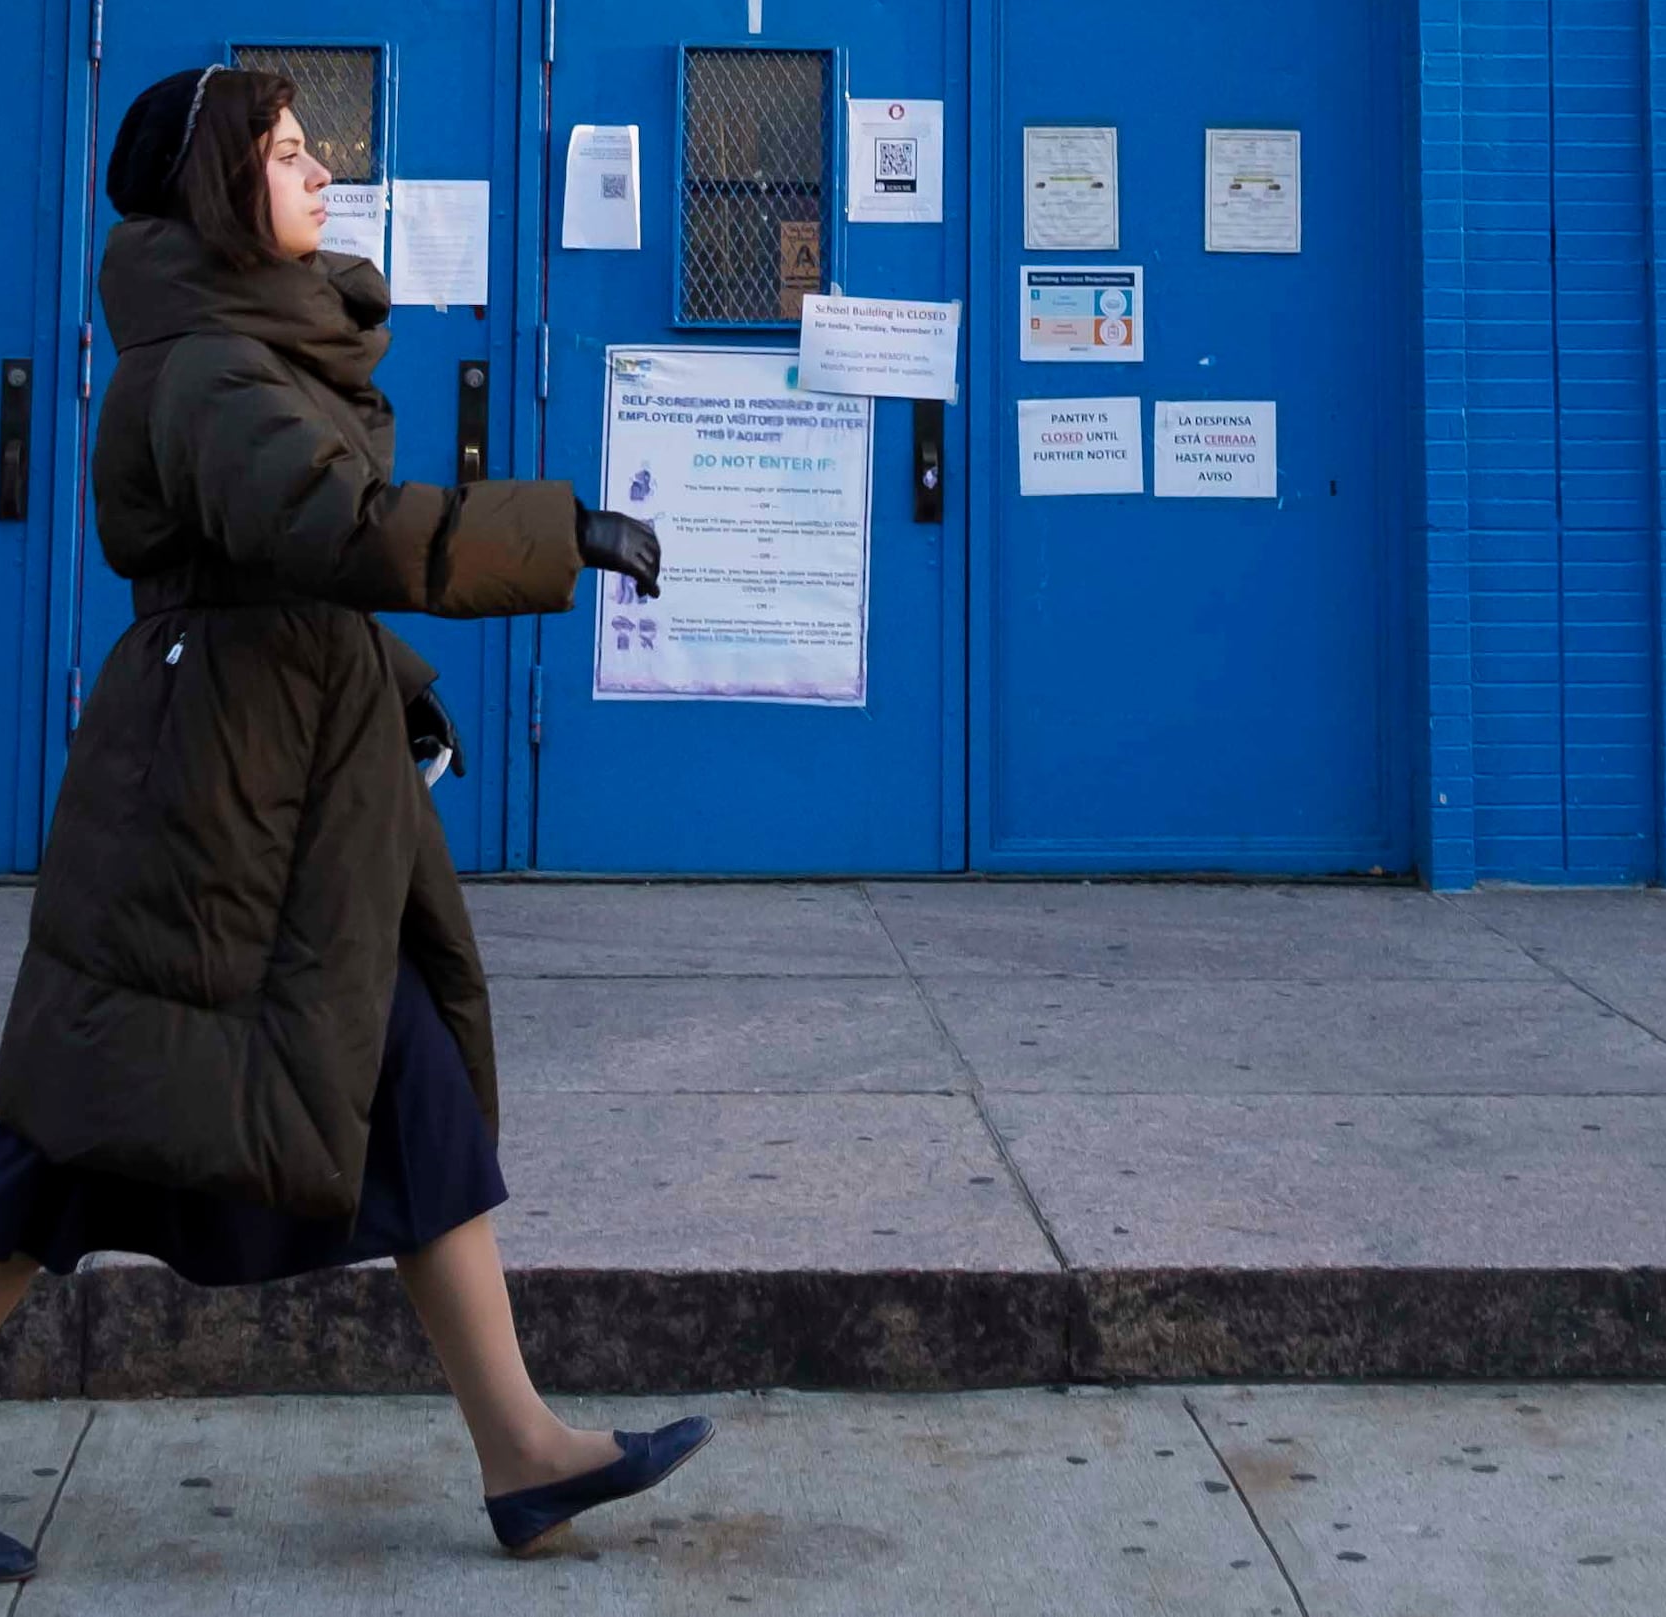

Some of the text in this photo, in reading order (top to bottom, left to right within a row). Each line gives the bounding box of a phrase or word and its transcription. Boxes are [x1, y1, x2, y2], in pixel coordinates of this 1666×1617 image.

[333, 194, 374, 204] CLOSED
[815, 304, 947, 321] School Building is CLOSED
[891, 325, 931, 334] November
[621, 395, 731, 408] SELF-SCREENING
[734, 399, 745, 408] IS
[836, 402, 861, 413] ALL
[618, 410, 693, 423] EMPLOYEES
[695, 413, 724, 424] AND
[820, 417, 865, 428] ENTER
[1051, 413, 1108, 424] PANTRY IS
[1179, 416, 1252, 426] LA DESPENSA
[1041, 431, 1119, 444] CLOSED UNTIL
[1174, 433, 1257, 446] ESTÁ CERRADA
[1033, 449, 1128, 461] FURTHER NOTICE
[1175, 453, 1256, 464] HASTA NUEVO
[693, 454, 718, 468] DO
[720, 455, 756, 469] NOT
[759, 456, 813, 470] ENTER
[1198, 471, 1233, 482] AVISO
